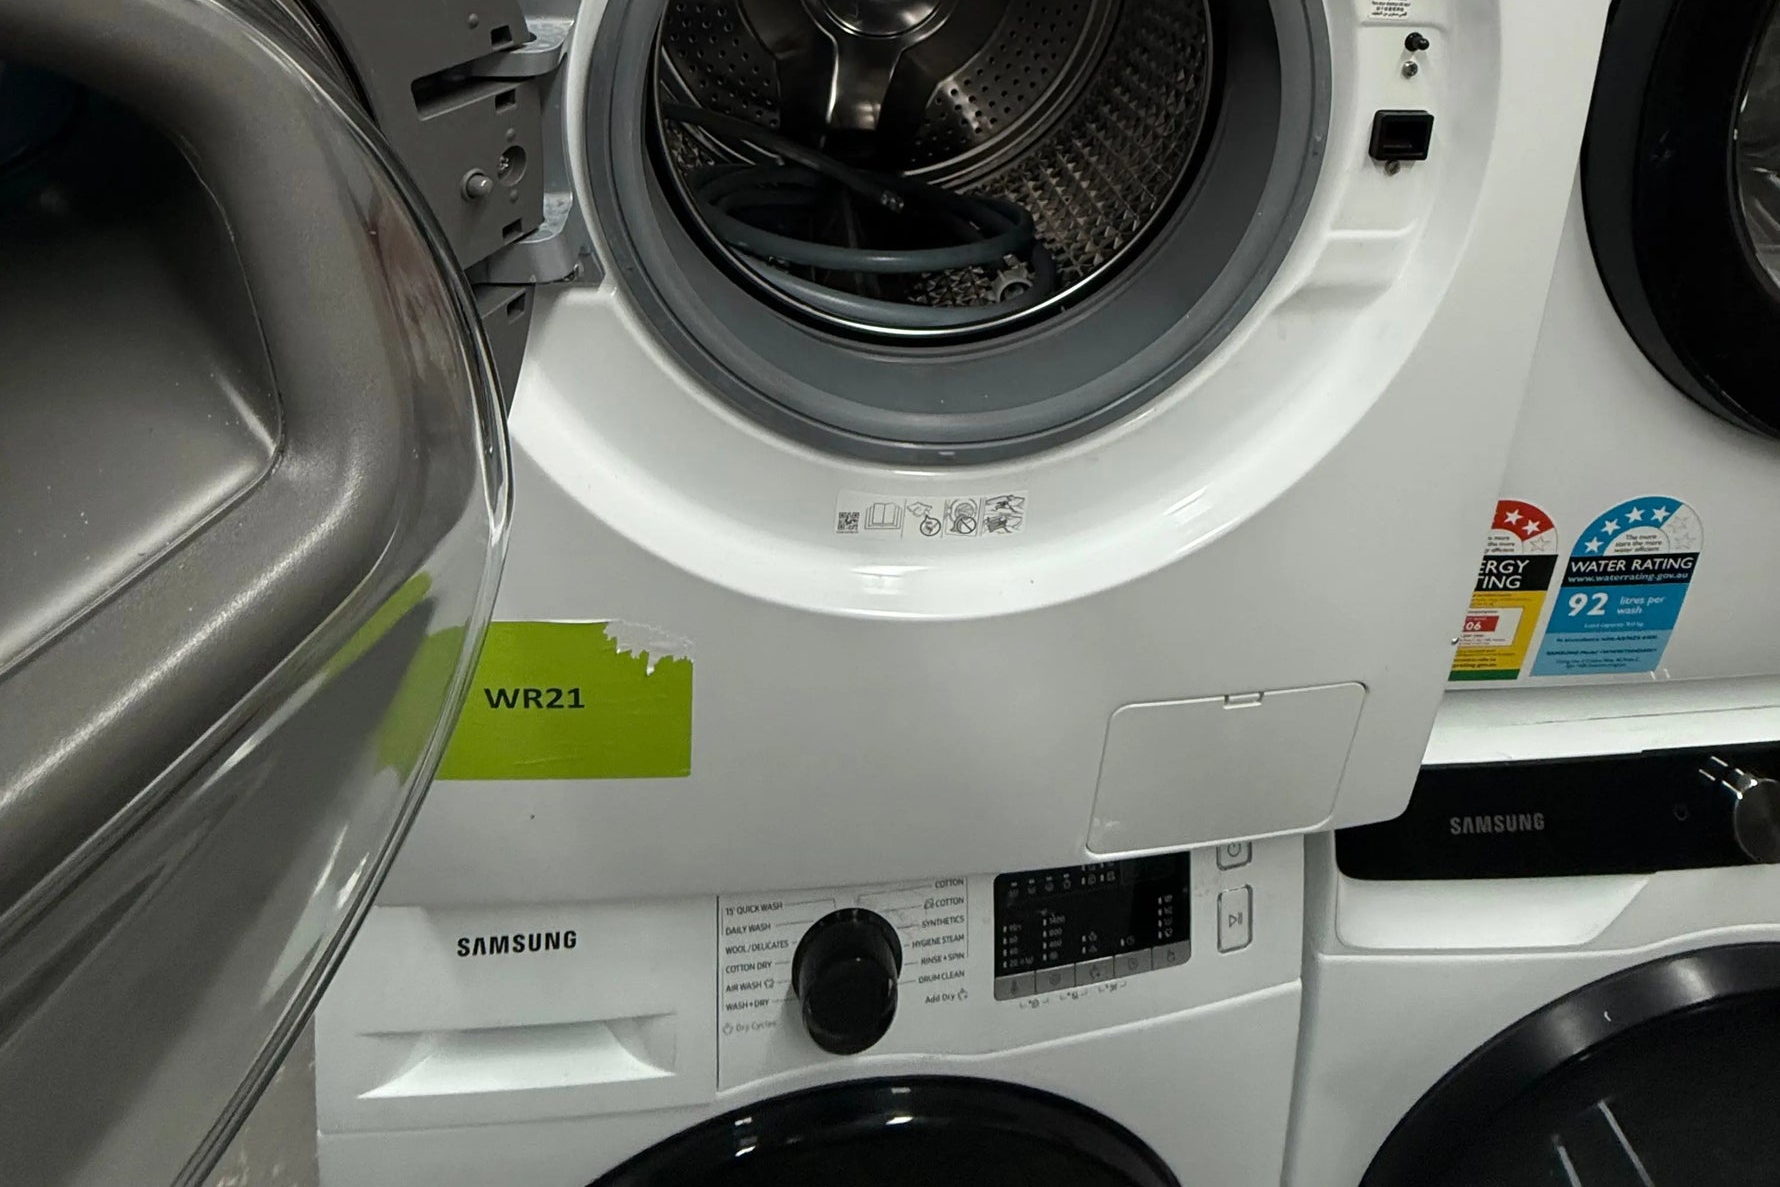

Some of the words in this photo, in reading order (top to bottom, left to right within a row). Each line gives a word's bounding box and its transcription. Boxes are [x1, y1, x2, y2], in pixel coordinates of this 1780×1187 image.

[1571, 559, 1627, 573] WATER
[1631, 557, 1694, 571] RATING
[1567, 572, 1689, 583] www.waterrating.gov.au
[1568, 592, 1609, 617] 92
[1620, 596, 1645, 606] litres
[1647, 596, 1667, 606] per
[1617, 606, 1643, 615] wash
[484, 688, 585, 709] WR21
[1450, 812, 1545, 835] SAMSUNG
[935, 878, 964, 889] COTTON
[737, 905, 760, 915] QUICK
[760, 901, 783, 912] WASH
[935, 897, 964, 908] COTTON
[922, 915, 965, 928] SYNTHETICS
[725, 926, 747, 936] DAILY
[748, 923, 771, 933] WASH
[457, 930, 577, 957] SAMSUNG
[912, 936, 941, 948] HYGIENE
[942, 933, 964, 945] STEAM
[920, 955, 942, 965] RINSE
[947, 952, 965, 961] SPIN
[725, 963, 755, 974] COTTON
[757, 960, 772, 970] DRY
[918, 974, 940, 984] DRUM
[941, 970, 965, 980] CLEAN
[725, 984, 738, 993] AIR
[739, 980, 762, 991] WASH
[925, 994, 940, 1004] Add
[942, 992, 955, 1002] Dry
[726, 1001, 748, 1011] WASH
[754, 999, 769, 1007] DRY
